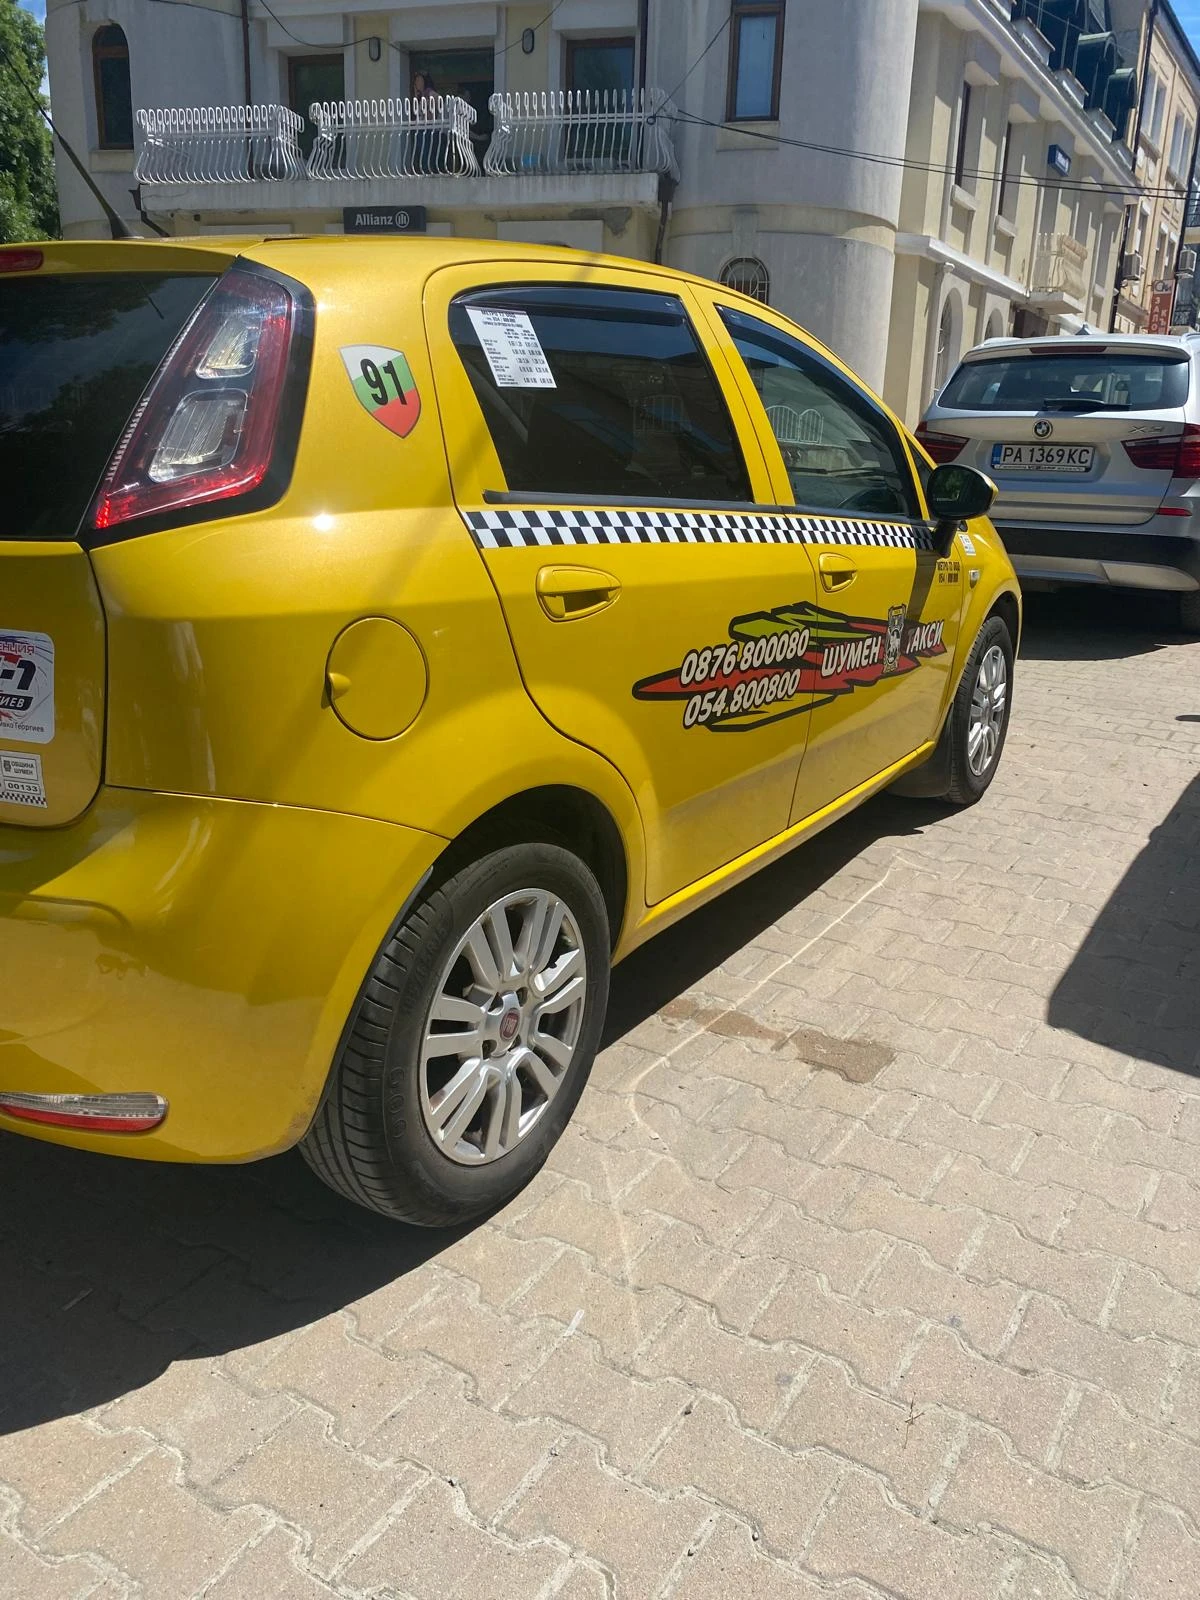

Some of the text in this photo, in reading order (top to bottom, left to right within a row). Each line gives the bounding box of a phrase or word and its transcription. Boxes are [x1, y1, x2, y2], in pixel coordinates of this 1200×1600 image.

[355, 213, 393, 226] Allianz
[360, 358, 408, 406] 91
[1003, 447, 1022, 462] PA
[1029, 447, 1065, 463] 1369
[1067, 448, 1090, 464] KC
[680, 628, 810, 685] 0876 800080
[821, 621, 944, 677] ШУМЕН ТАКСИ
[684, 668, 801, 726] 054 800800
[7, 782, 39, 792] 00133
